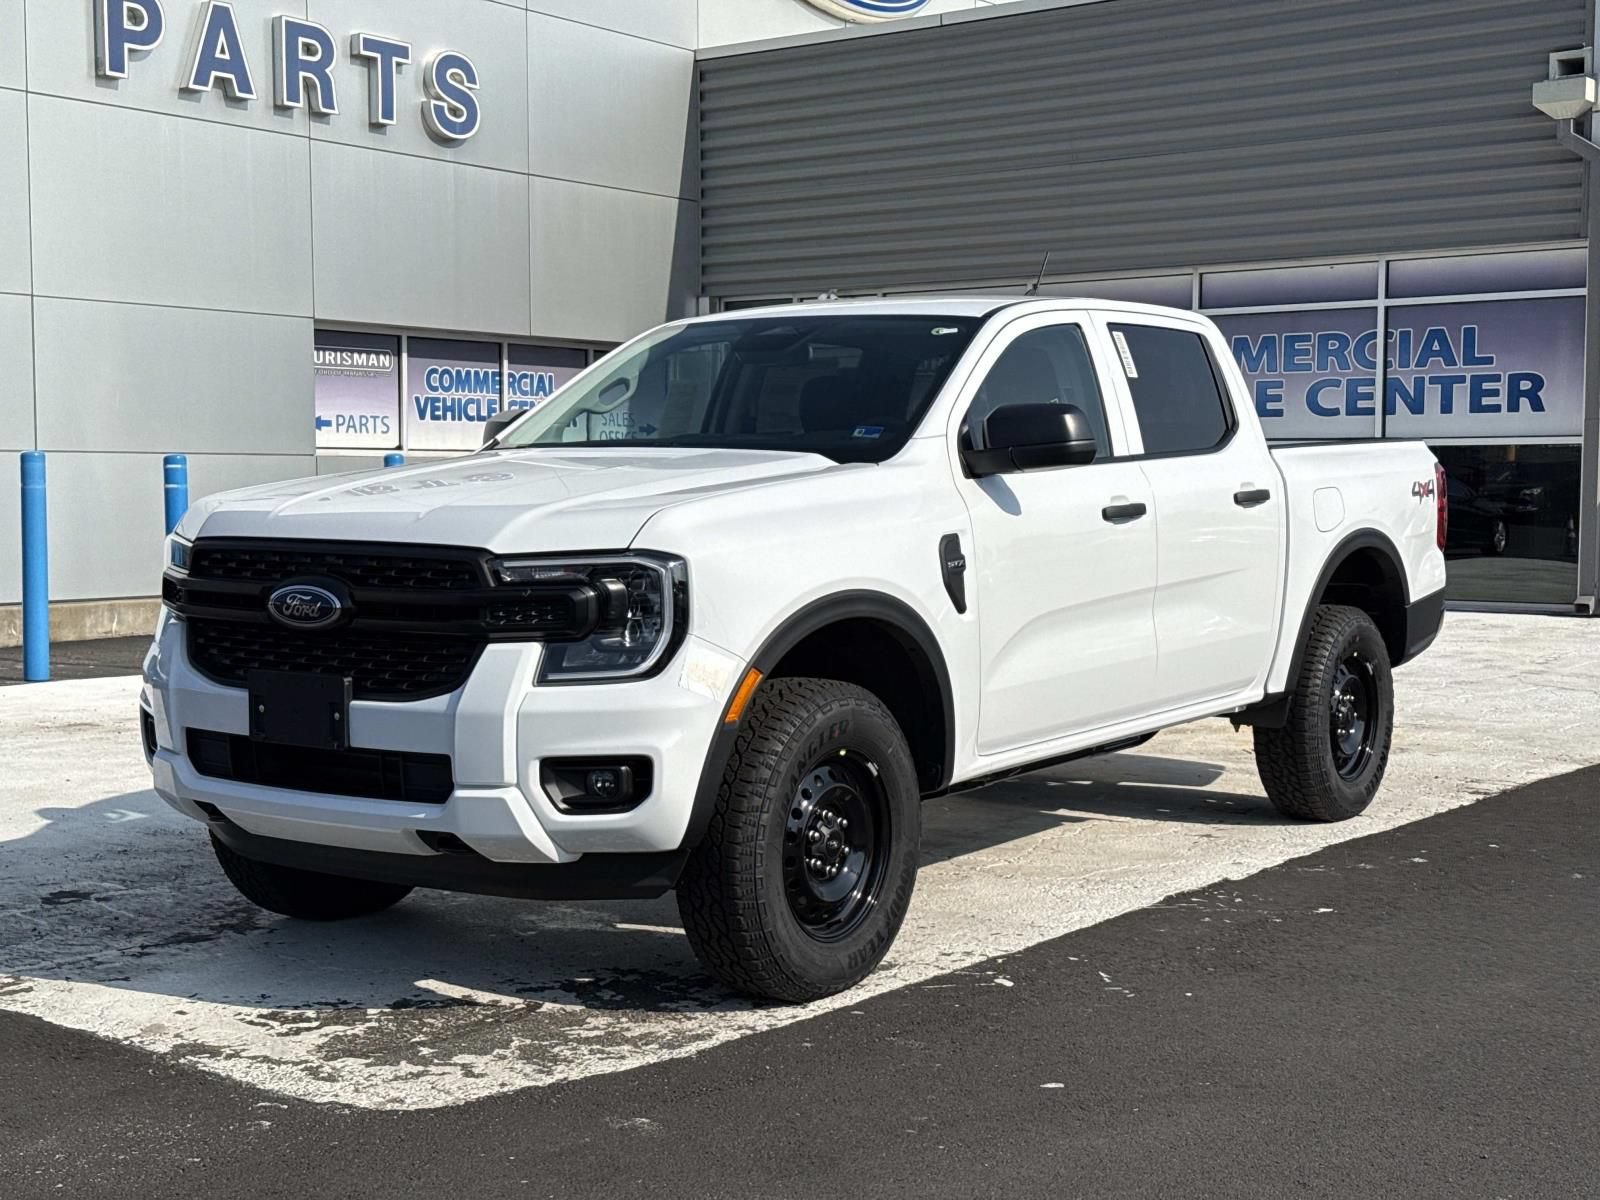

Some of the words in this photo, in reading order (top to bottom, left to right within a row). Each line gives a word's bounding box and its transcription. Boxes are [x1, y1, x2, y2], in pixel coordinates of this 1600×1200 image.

[98, 0, 481, 140] PARTS
[424, 366, 556, 398] COMMERCIAL
[1305, 371, 1547, 419] CENTER
[413, 394, 499, 422] VEHICLE
[601, 413, 635, 427] SALES
[335, 414, 390, 434] PARTS
[282, 593, 322, 617] Ford
